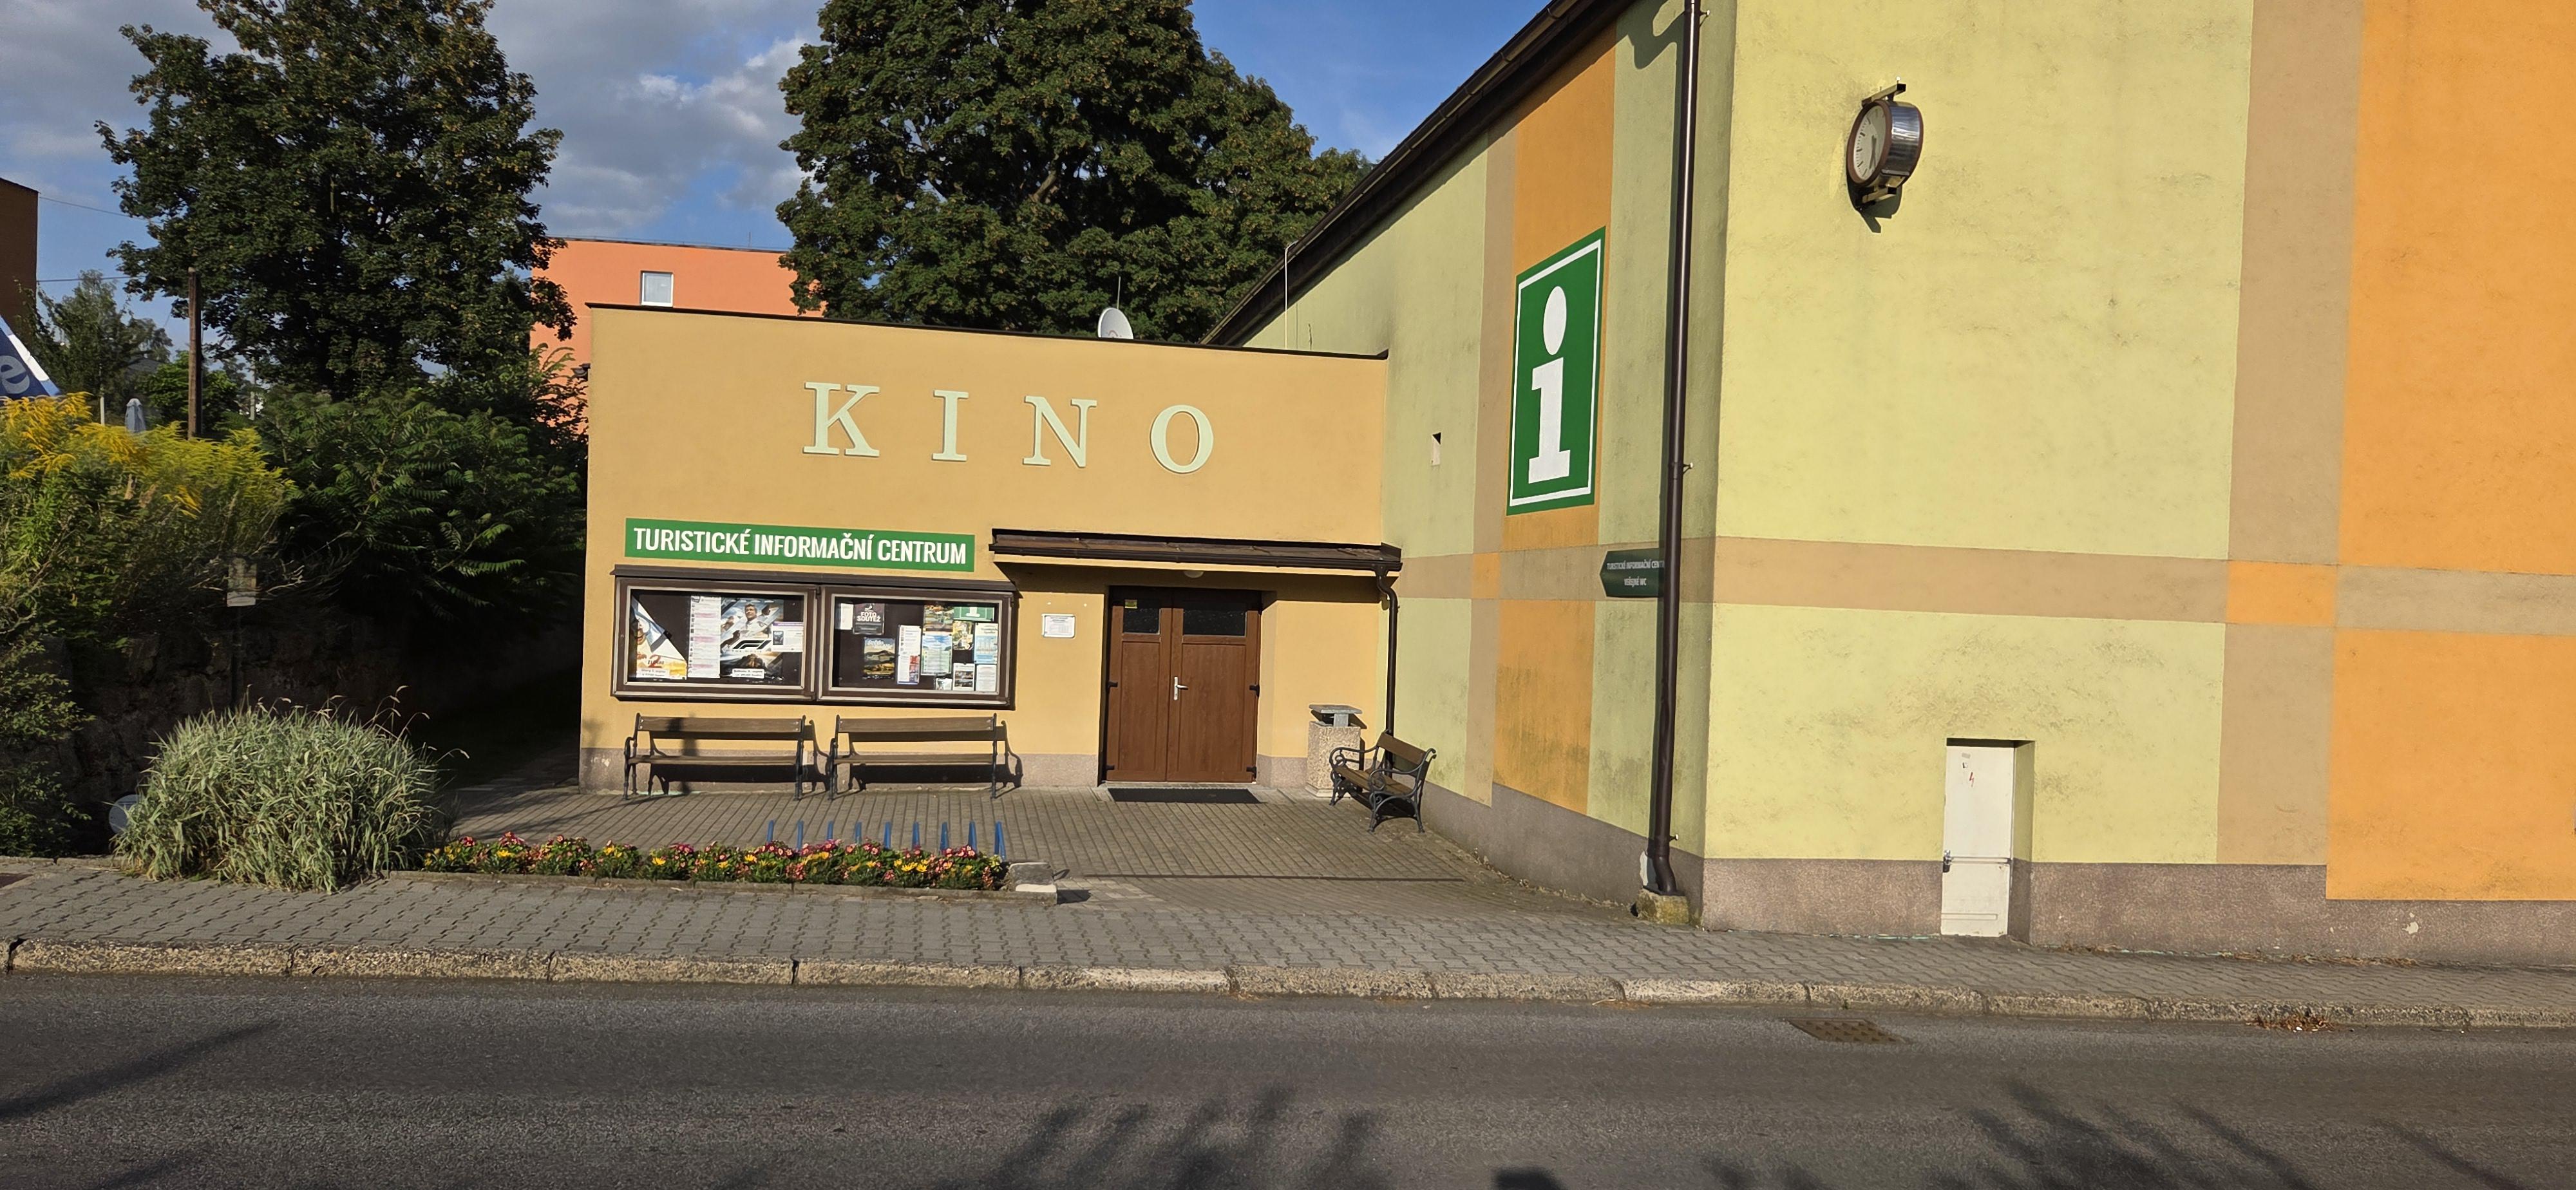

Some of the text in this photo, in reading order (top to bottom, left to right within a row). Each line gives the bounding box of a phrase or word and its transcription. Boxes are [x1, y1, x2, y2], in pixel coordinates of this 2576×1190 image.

[803, 381, 1214, 474] KINO
[1528, 285, 1570, 484] i
[633, 528, 966, 565] TURISTICKÉ INFORMAČNÍ CENTRUM
